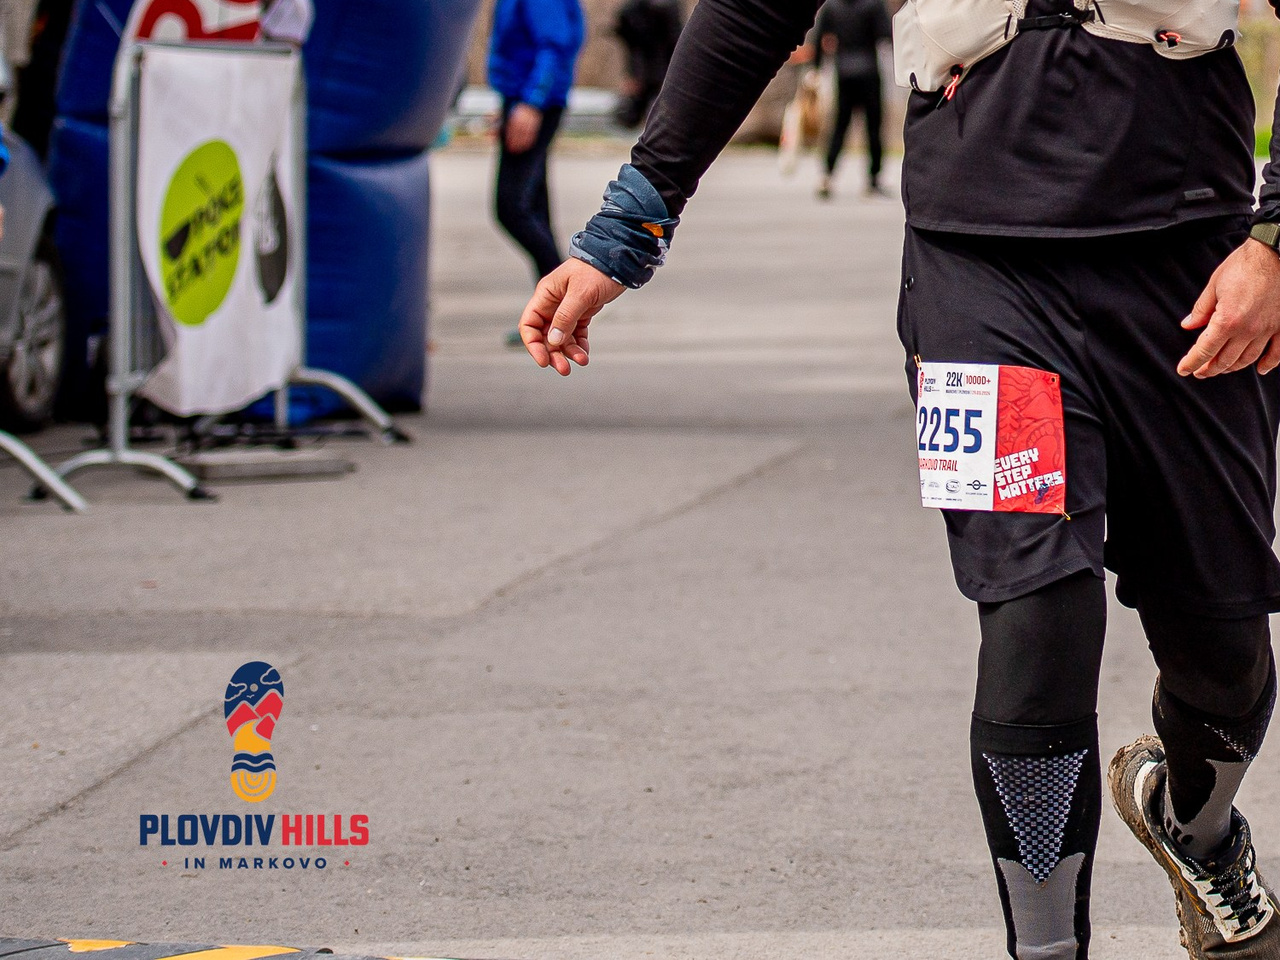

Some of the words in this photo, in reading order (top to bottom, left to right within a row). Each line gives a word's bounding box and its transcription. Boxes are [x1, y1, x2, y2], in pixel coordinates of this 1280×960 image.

[945, 371, 964, 388] 22K
[918, 406, 983, 454] 2255
[939, 459, 959, 472] TRAIL
[994, 447, 1040, 473] EVERY
[994, 464, 1032, 487] STEP
[997, 470, 1064, 501] MATTERS
